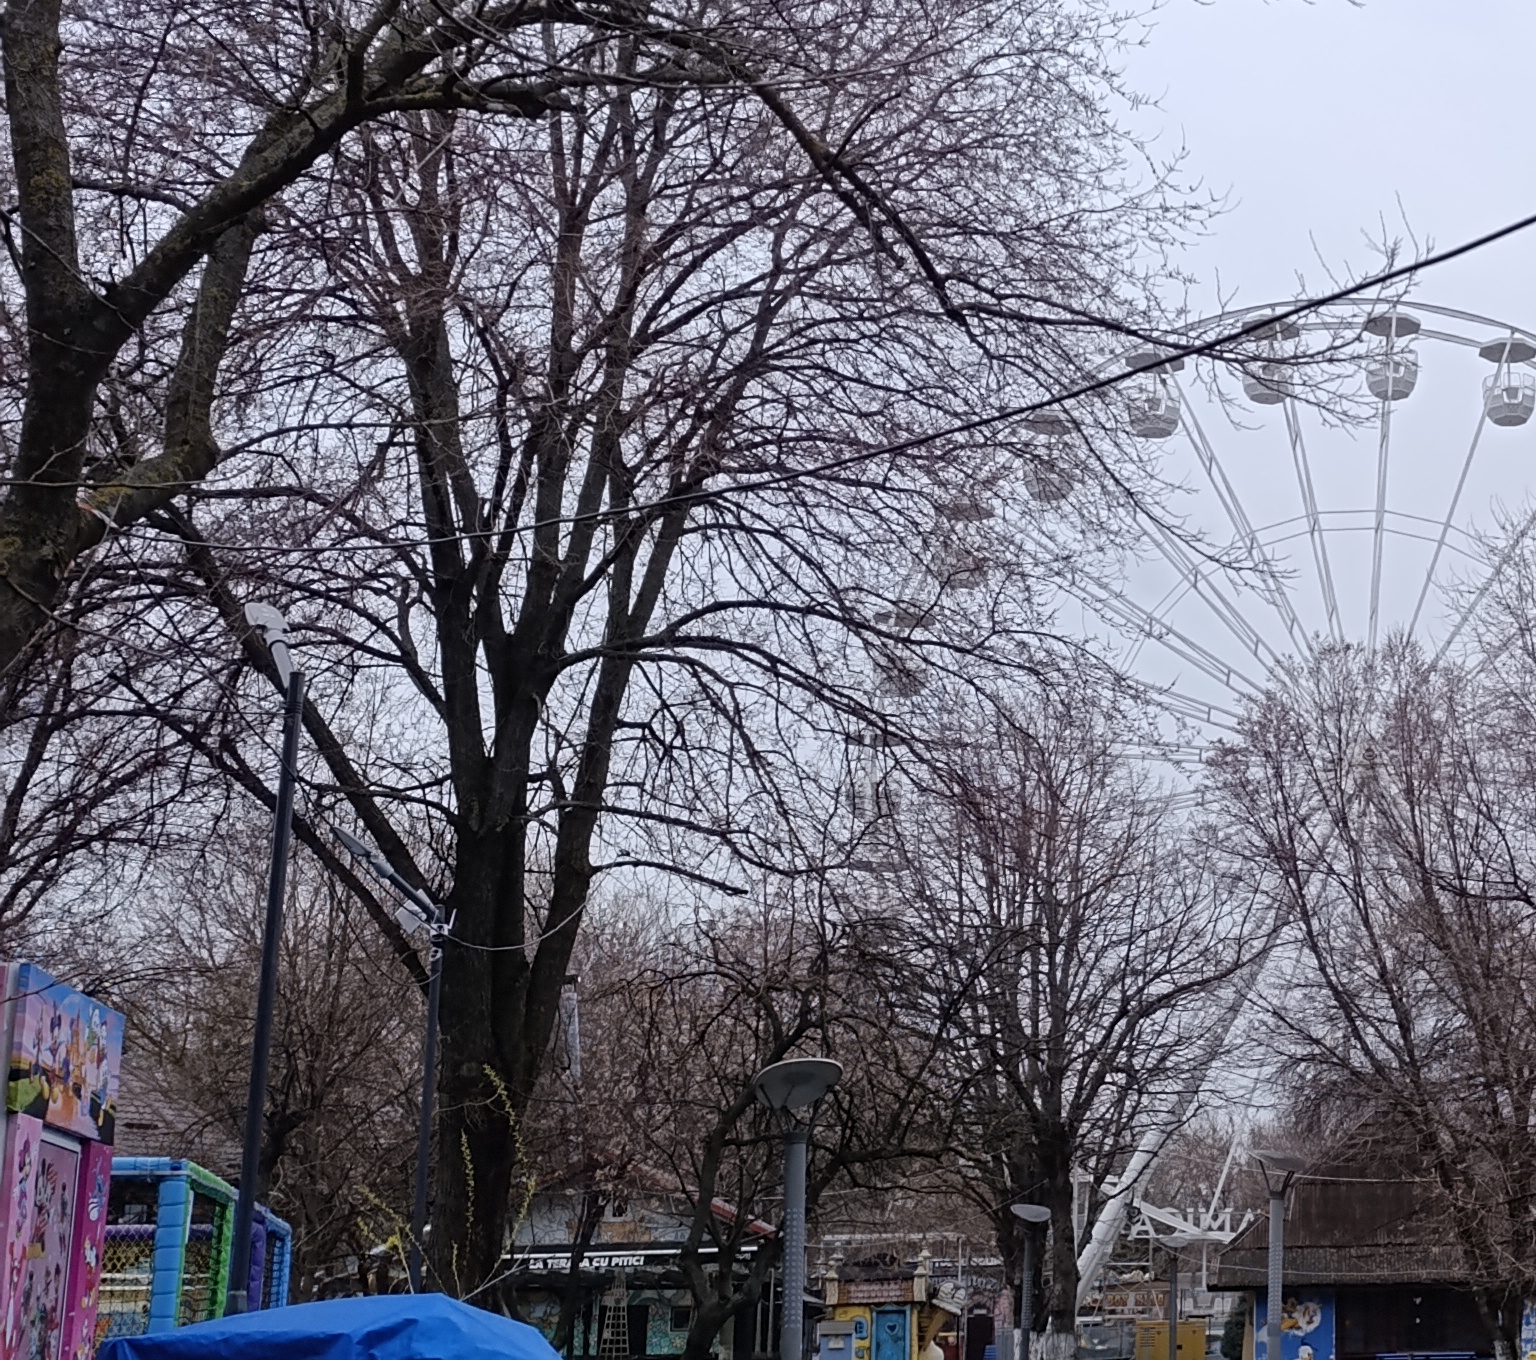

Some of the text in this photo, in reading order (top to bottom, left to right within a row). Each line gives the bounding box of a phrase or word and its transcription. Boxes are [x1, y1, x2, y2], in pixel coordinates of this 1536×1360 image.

[528, 1255, 645, 1269] LA TERAA CU PITICI
